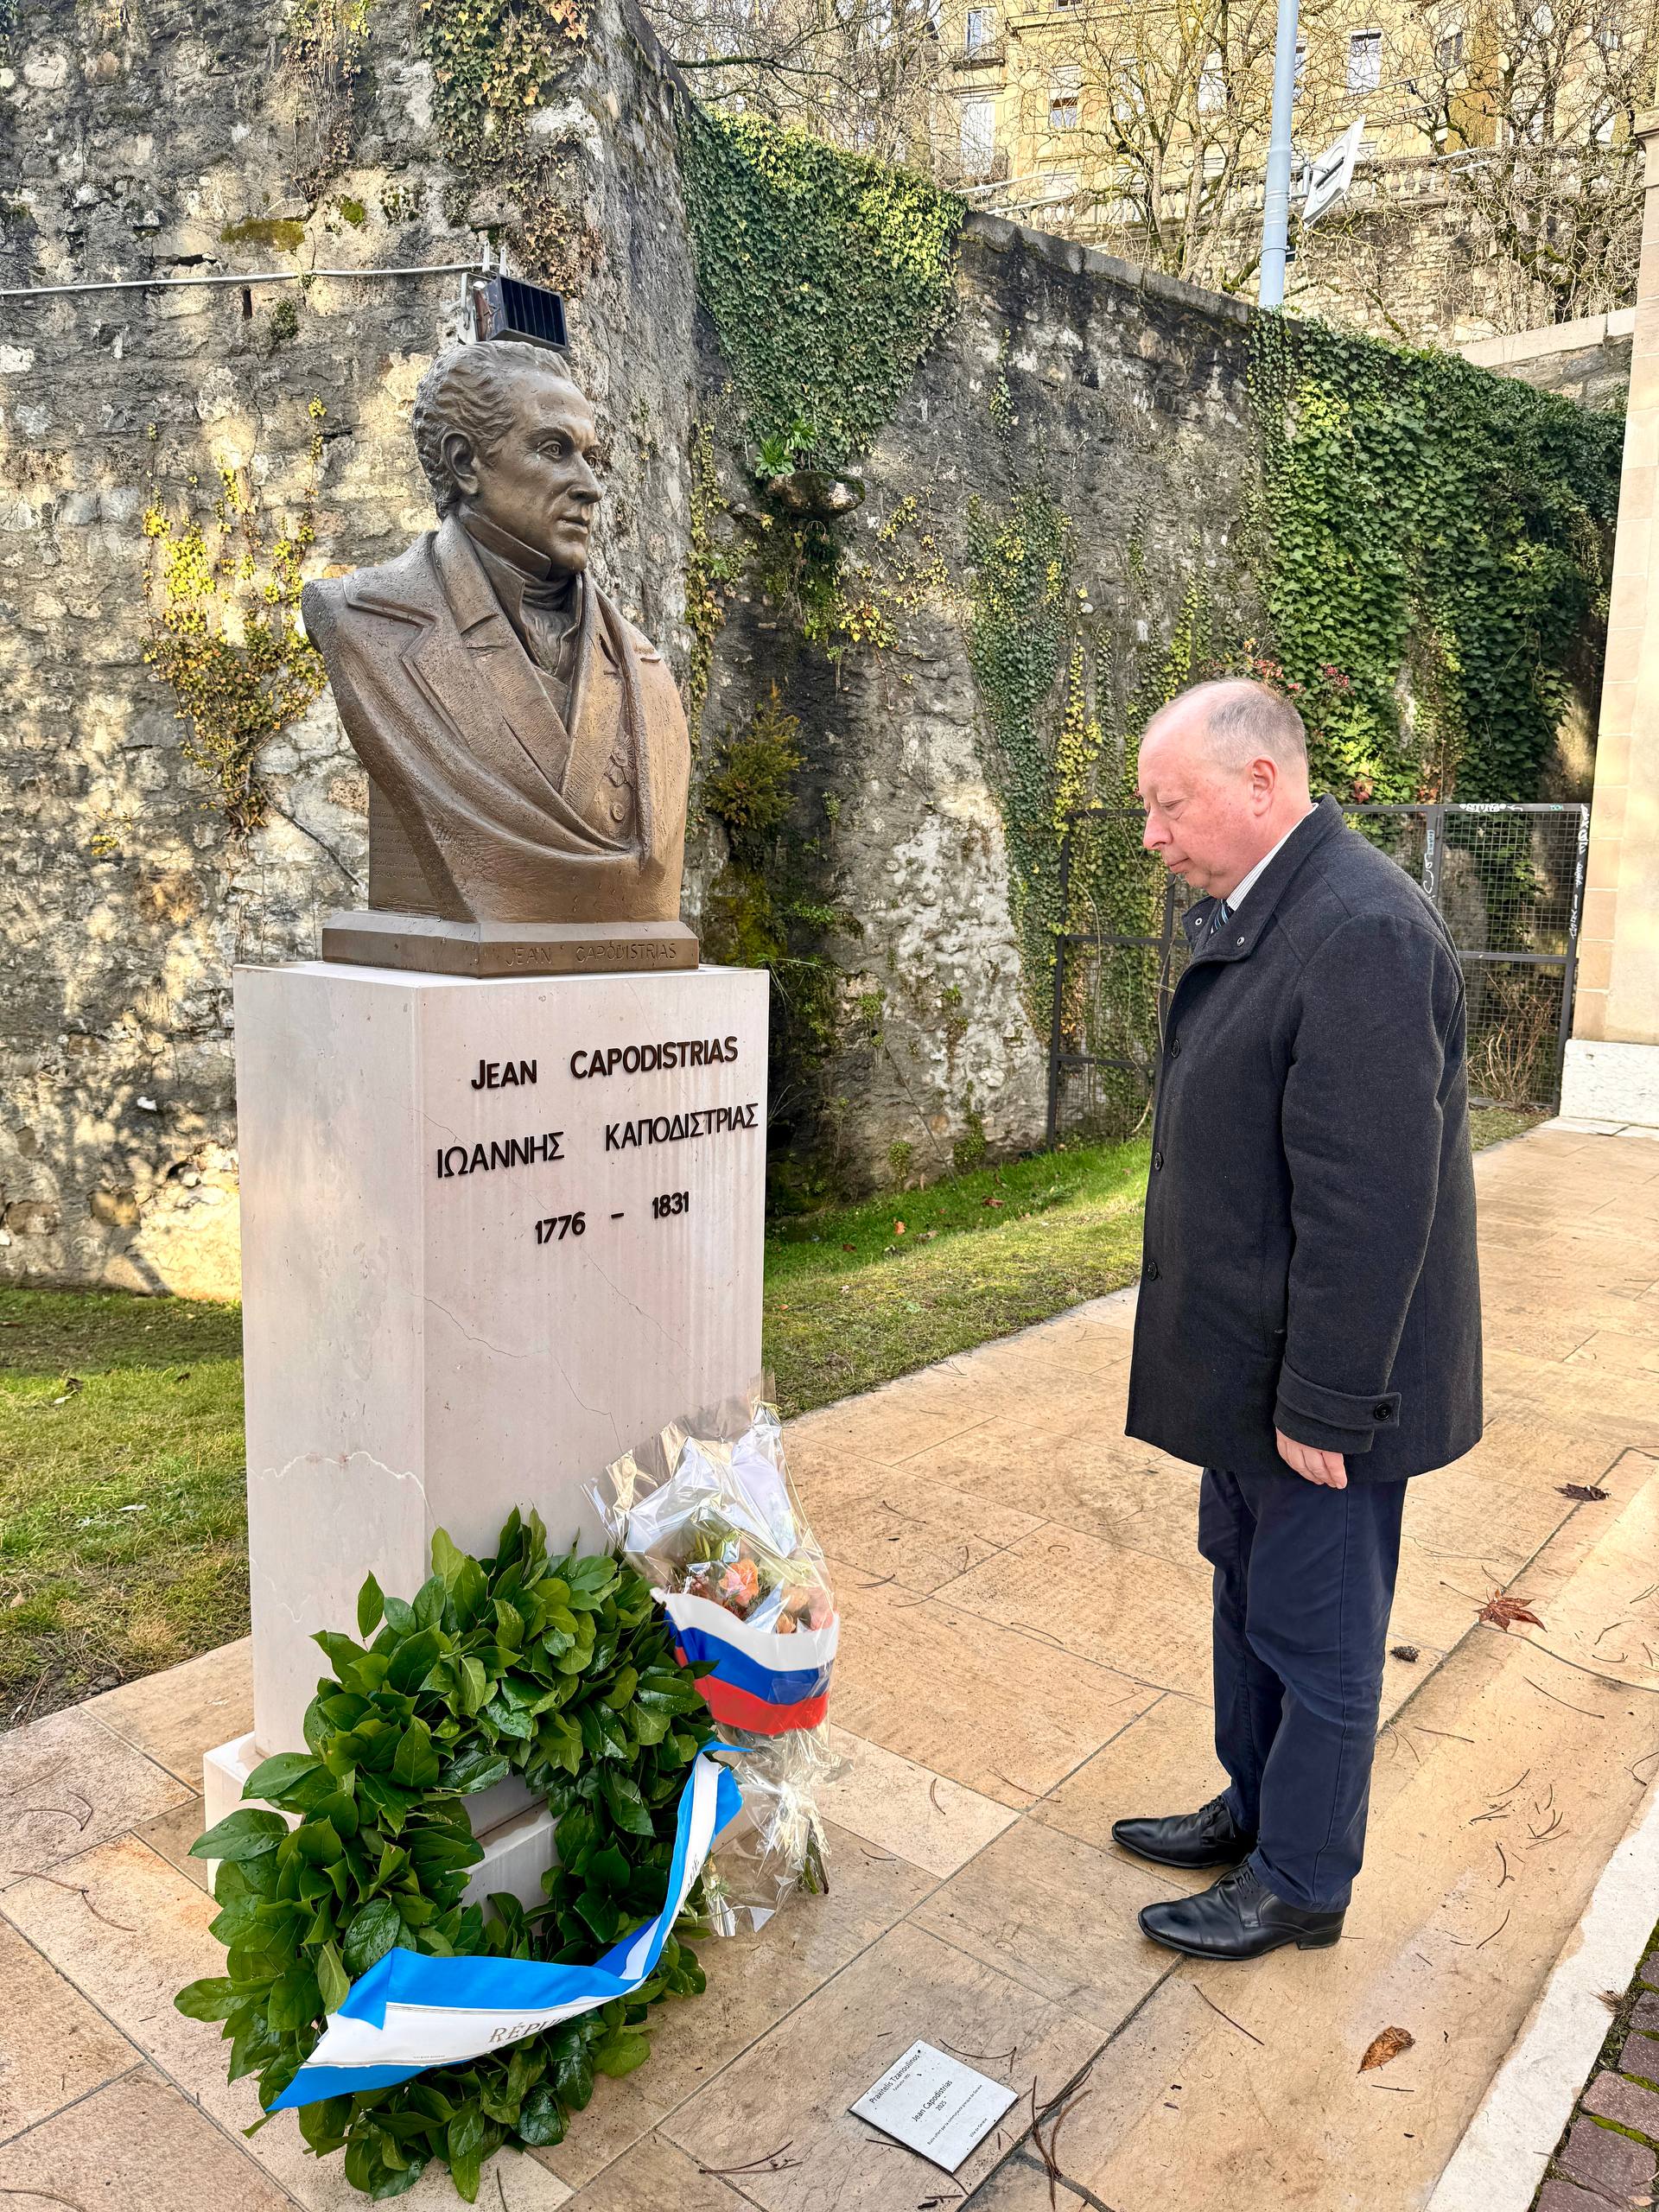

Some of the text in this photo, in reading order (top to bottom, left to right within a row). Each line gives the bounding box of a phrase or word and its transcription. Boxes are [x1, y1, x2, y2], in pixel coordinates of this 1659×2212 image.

[505, 943, 677, 967] JEAN CAPODISTRIAS
[471, 1037, 738, 1090] JEAN CAPODISTRIAS
[438, 1103, 758, 1178] ΙΩΑΝΝΗΣ ΚΑΠΟΔΙΣΤΡΙΑΣ
[536, 1211, 585, 1244] 1776
[652, 1192, 689, 1218] 1831
[868, 2082, 893, 2103] Praxitelis
[889, 2054, 919, 2082] Tzanoulinos
[912, 2080, 952, 2121] Jean Capodistrias
[935, 2100, 946, 2111] 2025
